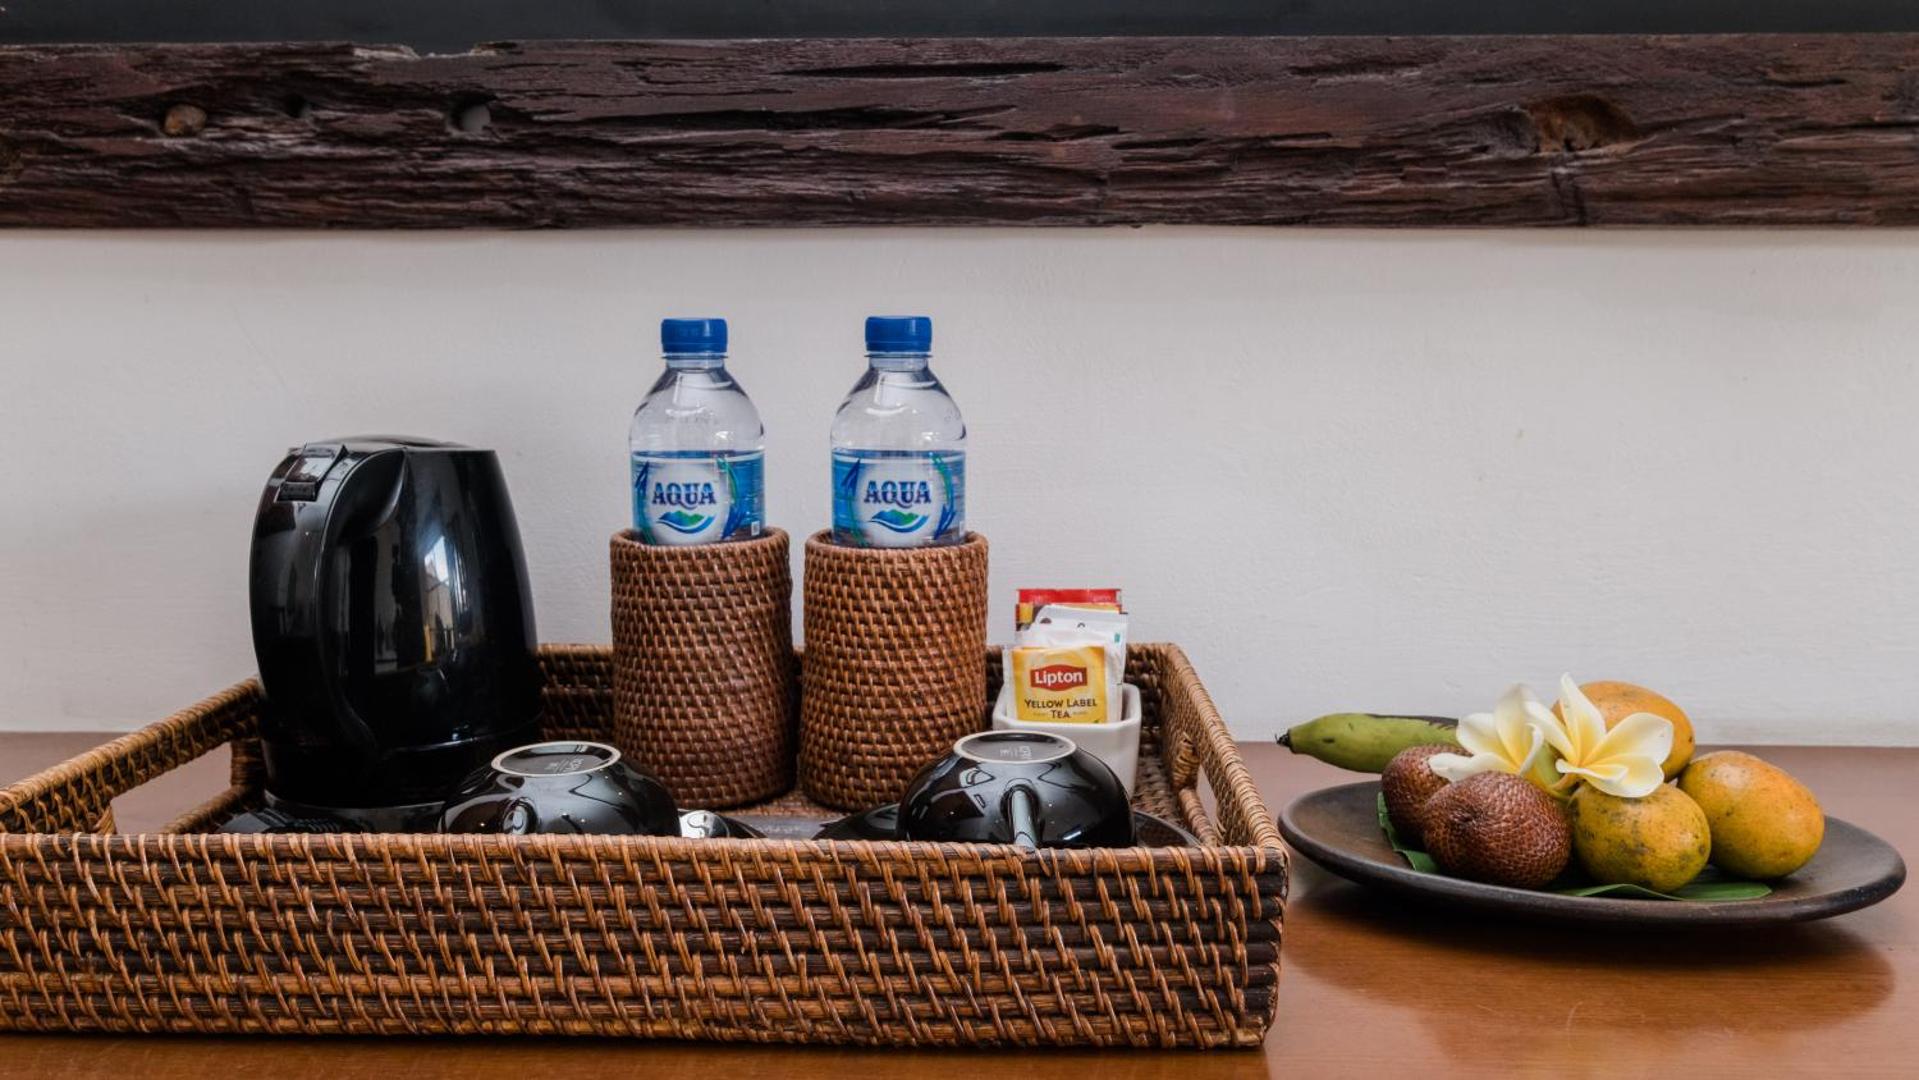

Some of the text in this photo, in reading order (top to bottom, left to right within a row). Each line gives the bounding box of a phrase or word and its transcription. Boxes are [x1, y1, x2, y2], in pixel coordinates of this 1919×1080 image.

[651, 482, 717, 510] AQUA
[863, 480, 931, 509] AQUA
[1034, 670, 1083, 687] Lipton
[1024, 698, 1098, 709] YELLOW LABEL
[1050, 710, 1071, 719] TEA
